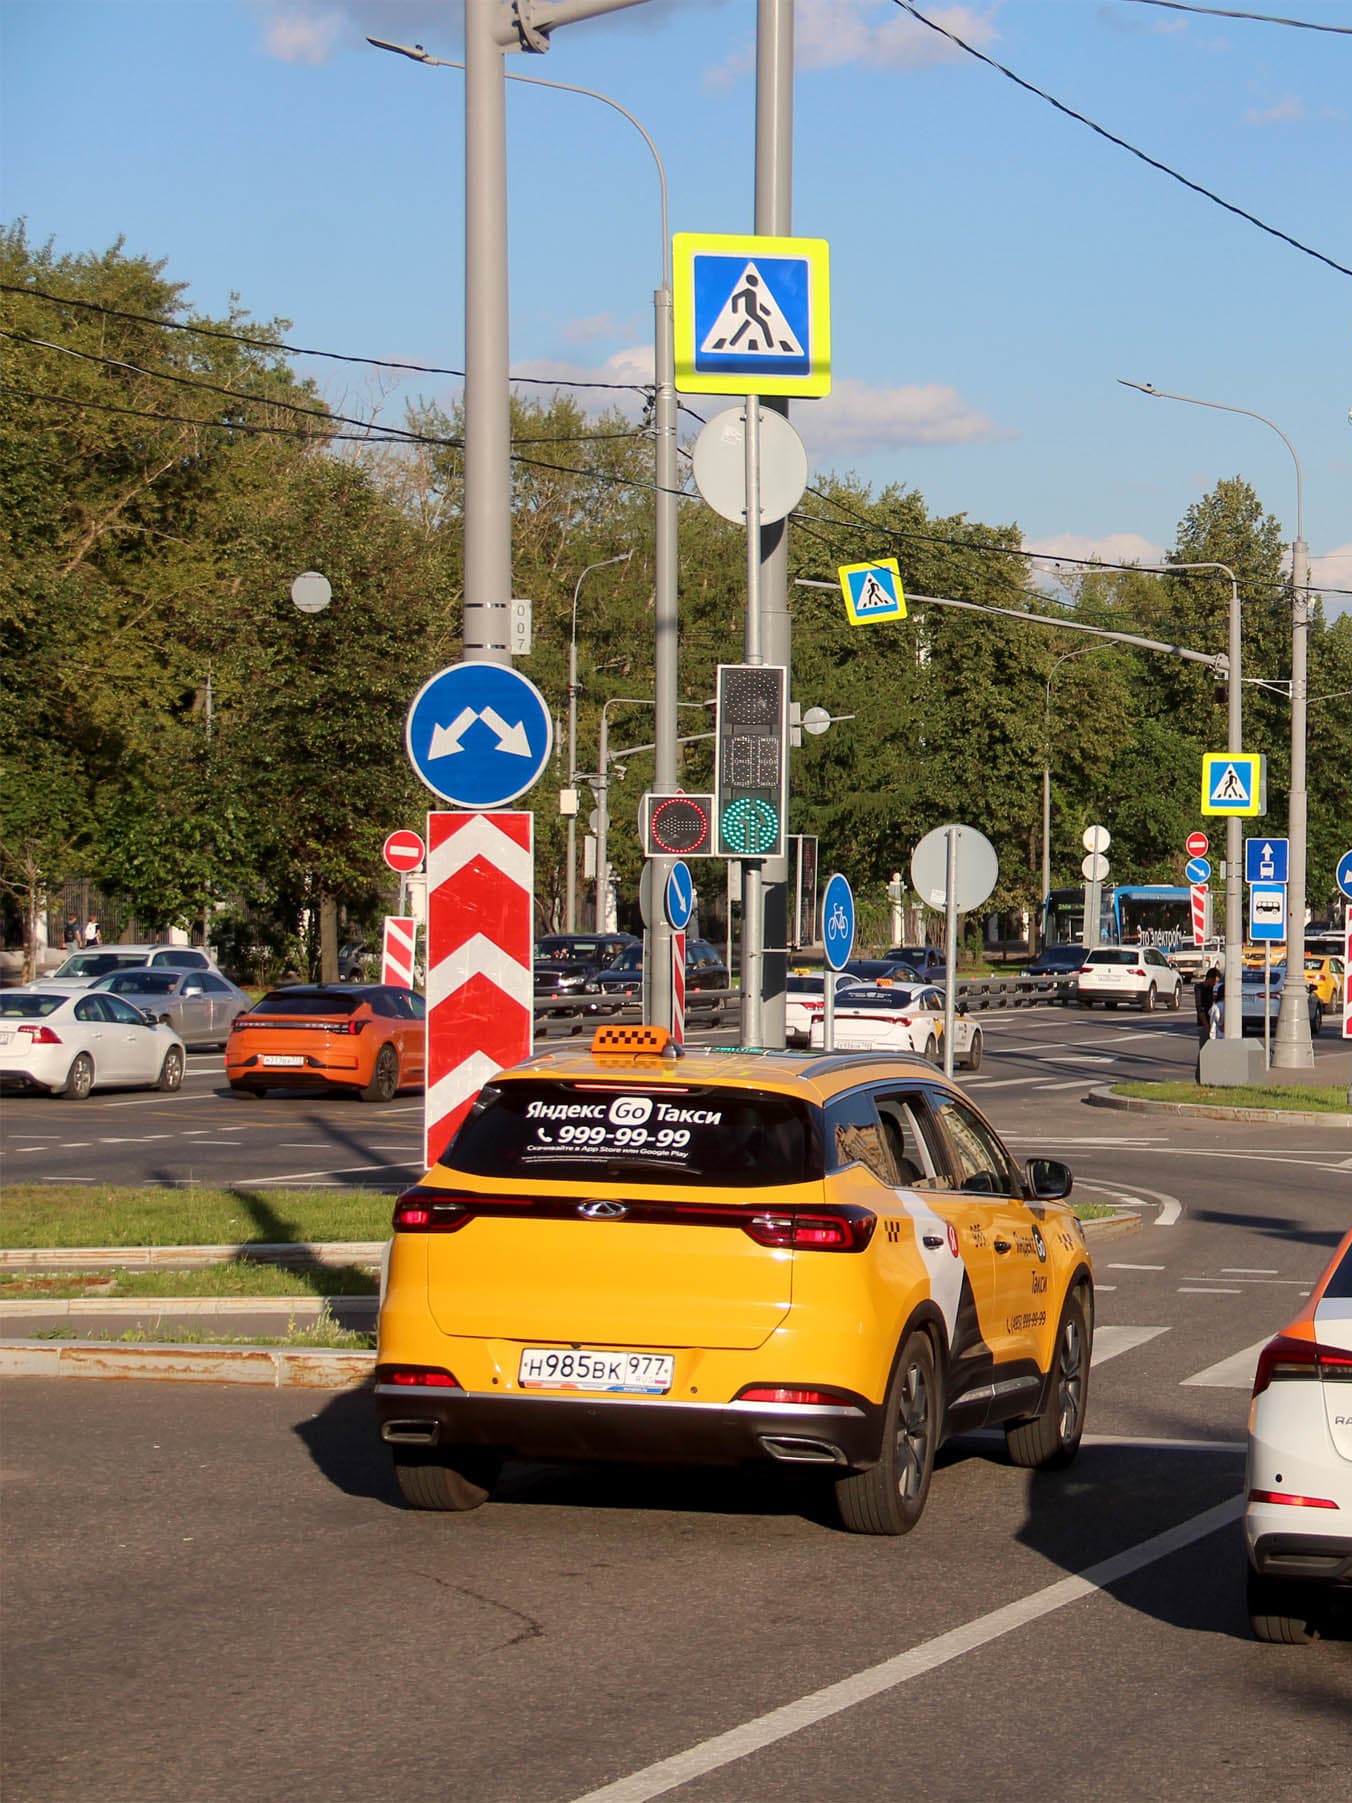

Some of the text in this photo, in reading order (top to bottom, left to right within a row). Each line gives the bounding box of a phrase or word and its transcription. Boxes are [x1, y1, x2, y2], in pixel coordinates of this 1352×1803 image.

[517, 605, 525, 650] 007
[526, 1101, 722, 1126] Яндекс Go Такси
[557, 1125, 691, 1148] 999-99-99
[581, 1145, 599, 1154] App
[599, 1146, 622, 1154] Store
[639, 1148, 670, 1158] Google
[670, 1150, 689, 1160] Play
[528, 1354, 666, 1380] Н985ВК 977
